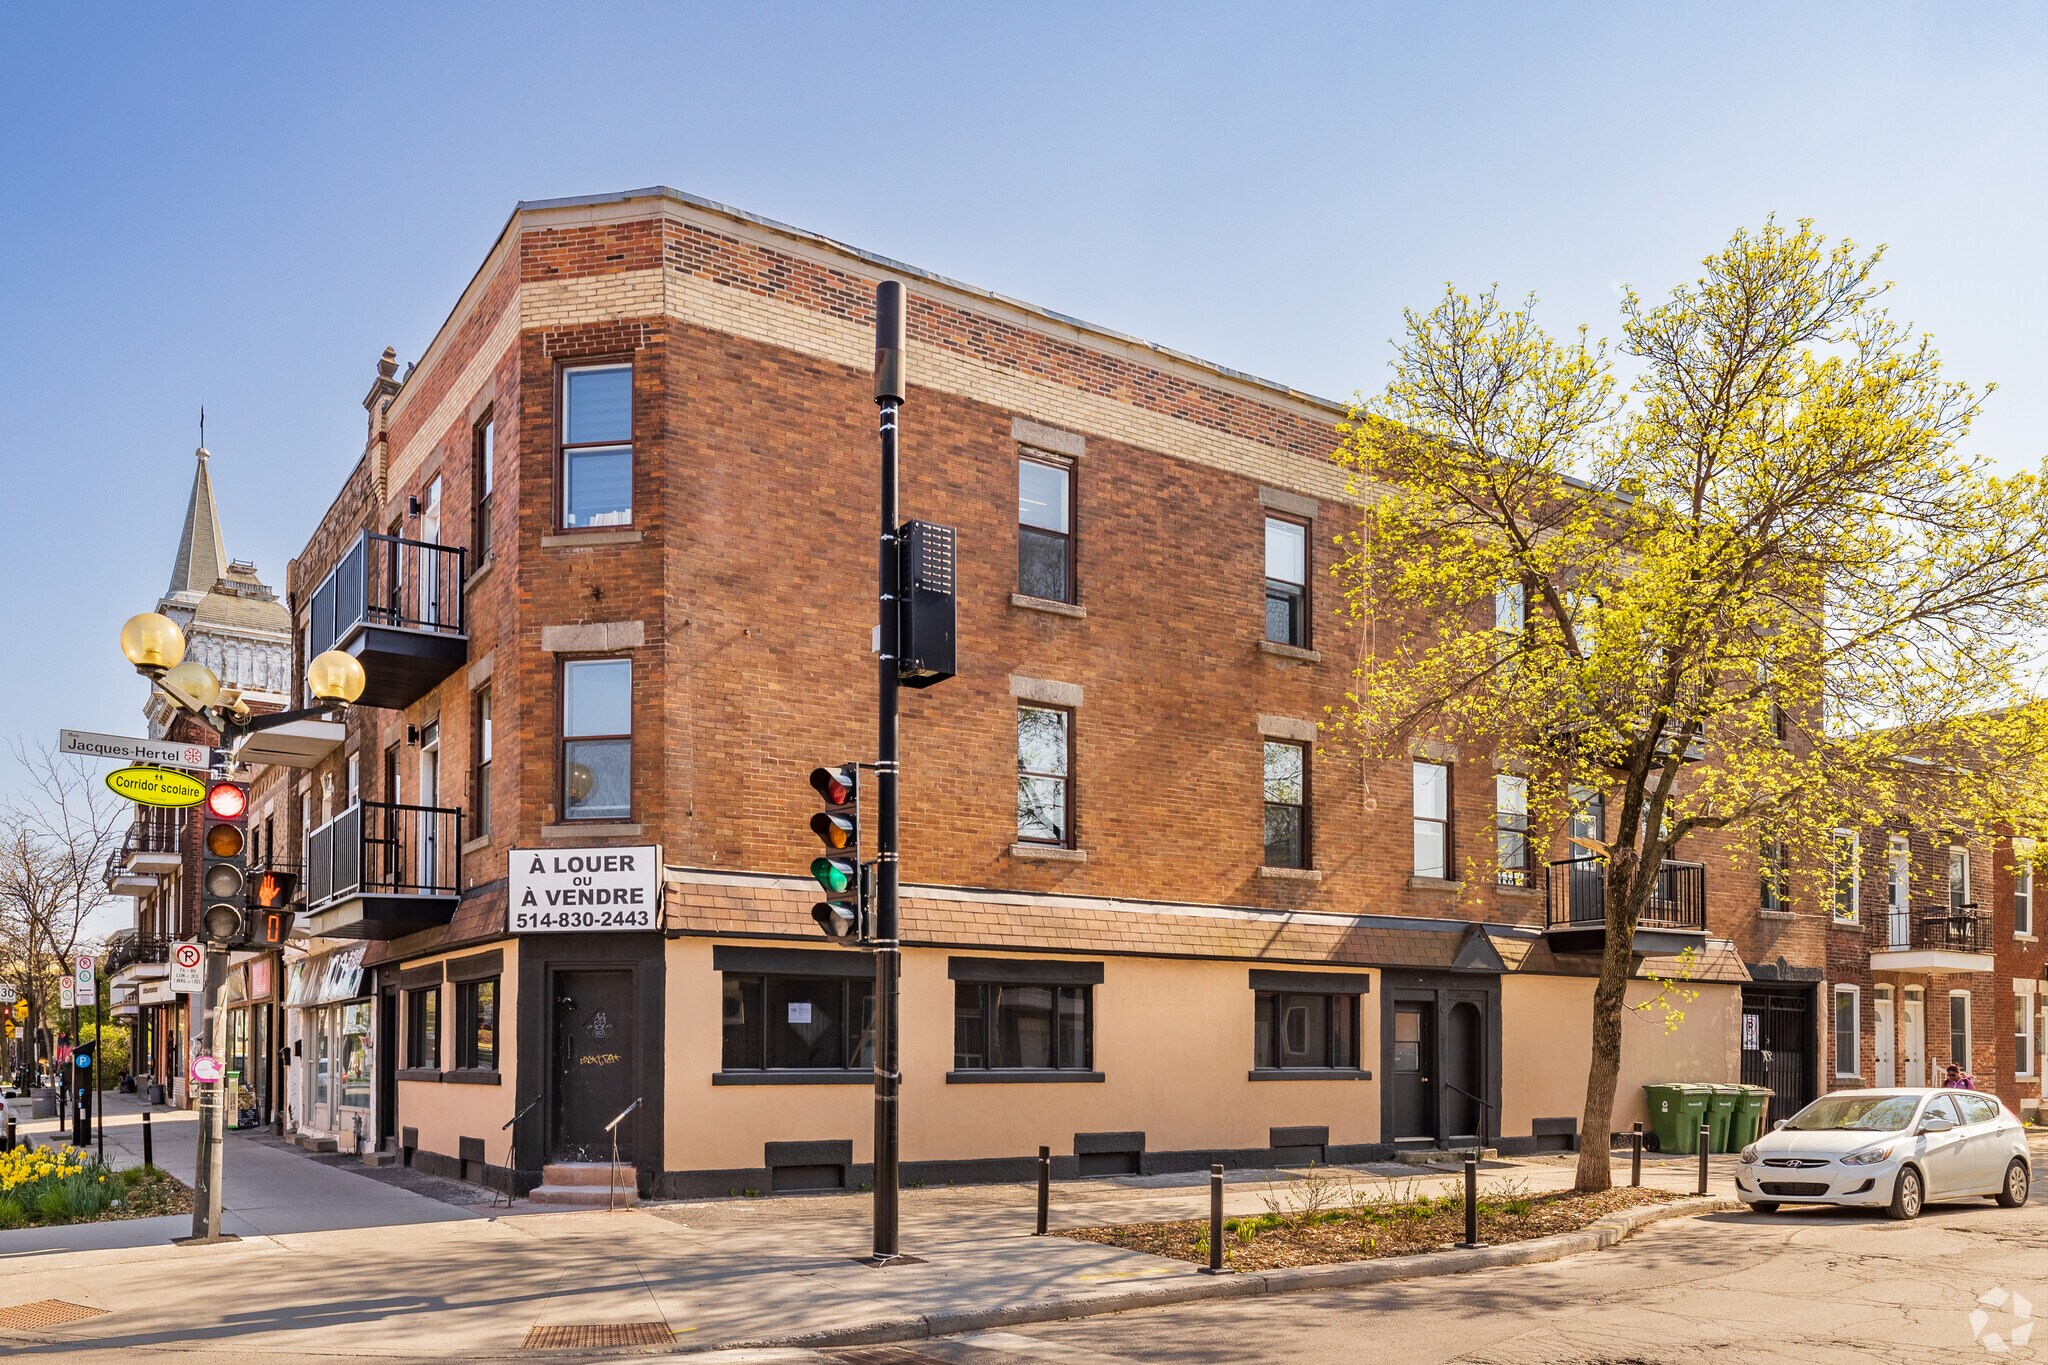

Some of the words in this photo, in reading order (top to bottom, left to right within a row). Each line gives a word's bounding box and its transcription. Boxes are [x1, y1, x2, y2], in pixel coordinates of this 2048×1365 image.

[68, 738, 180, 762] Jacques-Hertel
[116, 775, 158, 792] Corridor
[161, 784, 200, 797] scolaire
[529, 853, 546, 874] À
[554, 855, 635, 874] LOUER
[573, 876, 592, 887] OU
[521, 886, 538, 907] À
[545, 887, 644, 906] VENDRE
[516, 910, 649, 928] 514-830-2443
[1, 988, 14, 998] 30
